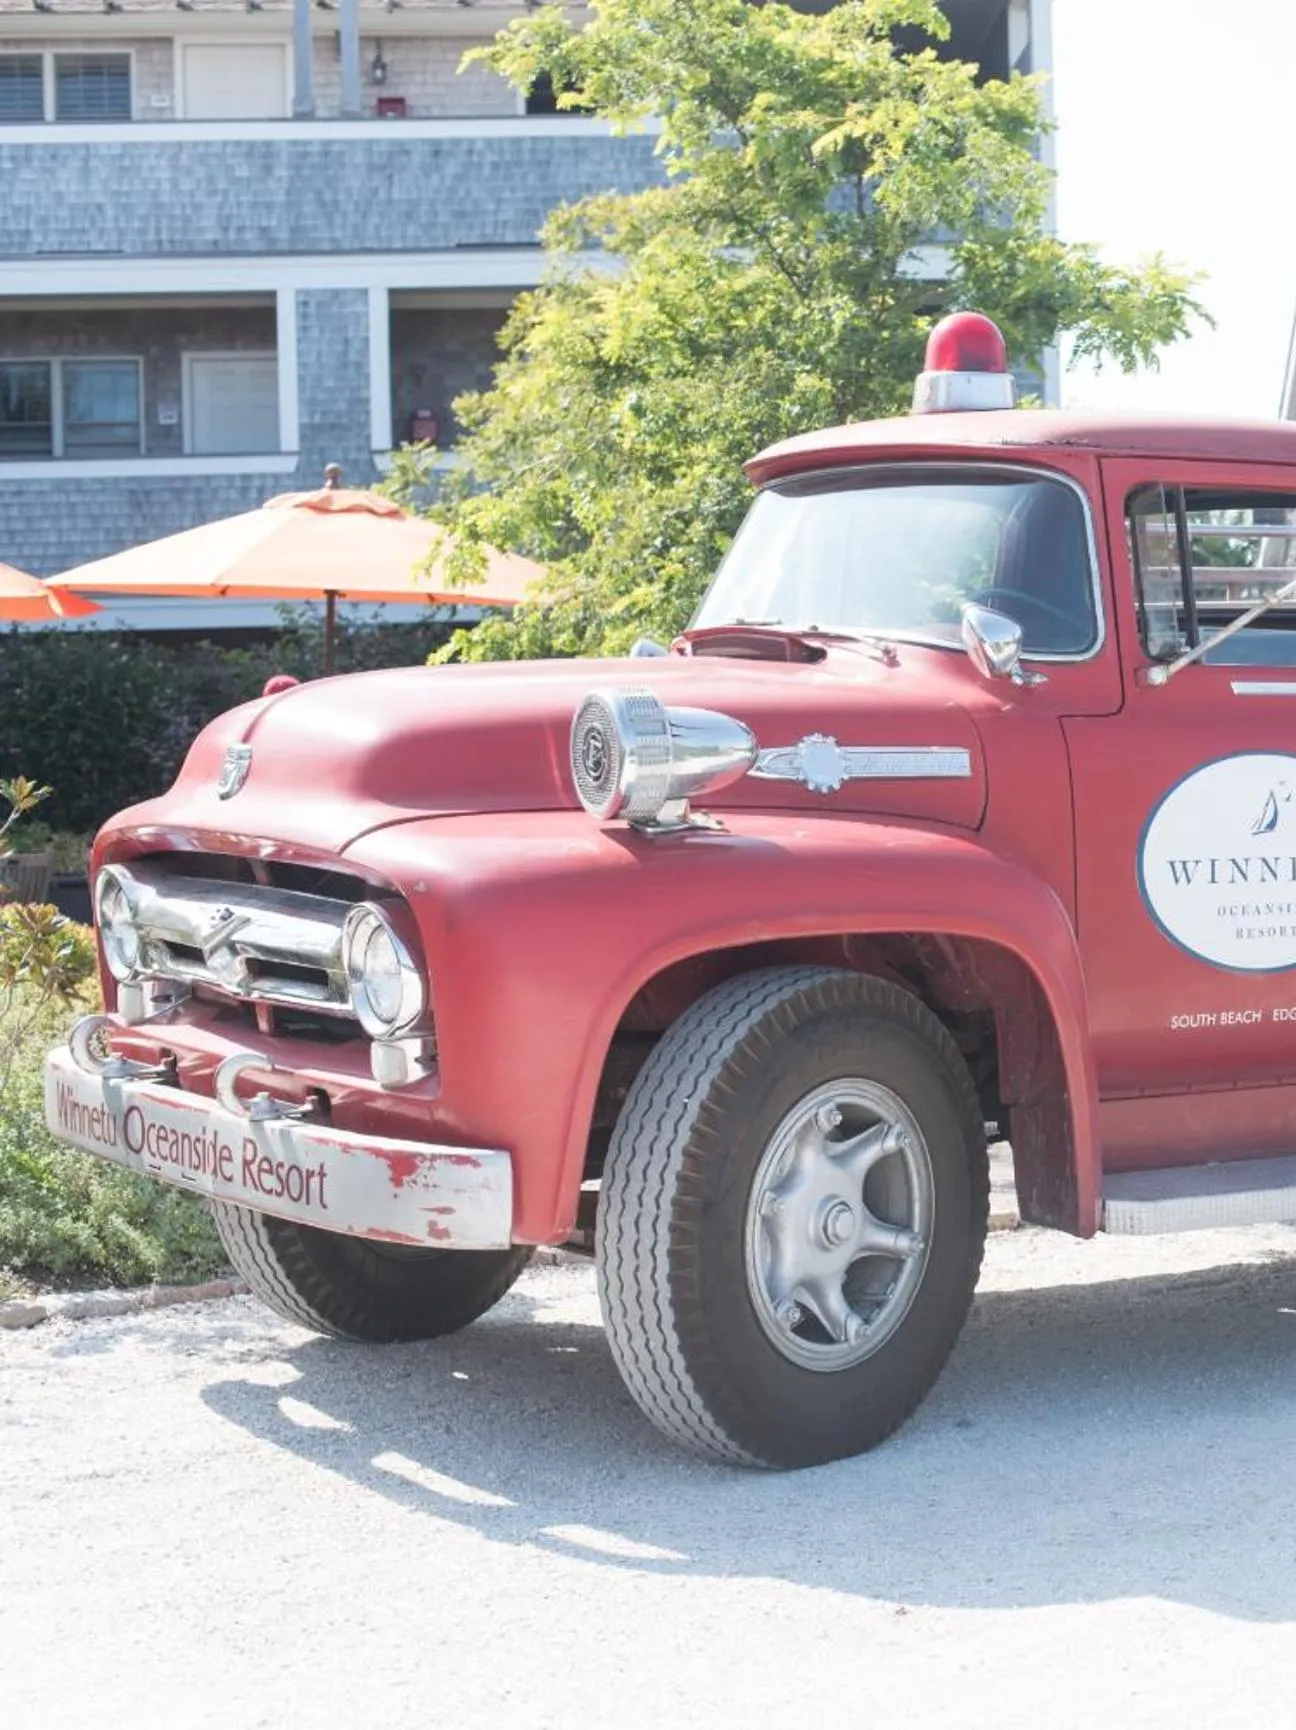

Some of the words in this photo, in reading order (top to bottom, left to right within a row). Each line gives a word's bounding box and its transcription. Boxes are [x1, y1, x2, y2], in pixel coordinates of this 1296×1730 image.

[1170, 1012, 1216, 1030] SOUTH
[1220, 1009, 1262, 1026] BEACH
[56, 1081, 117, 1147] Winnetu
[123, 1105, 234, 1183] Oceanside
[242, 1137, 328, 1210] Resort
